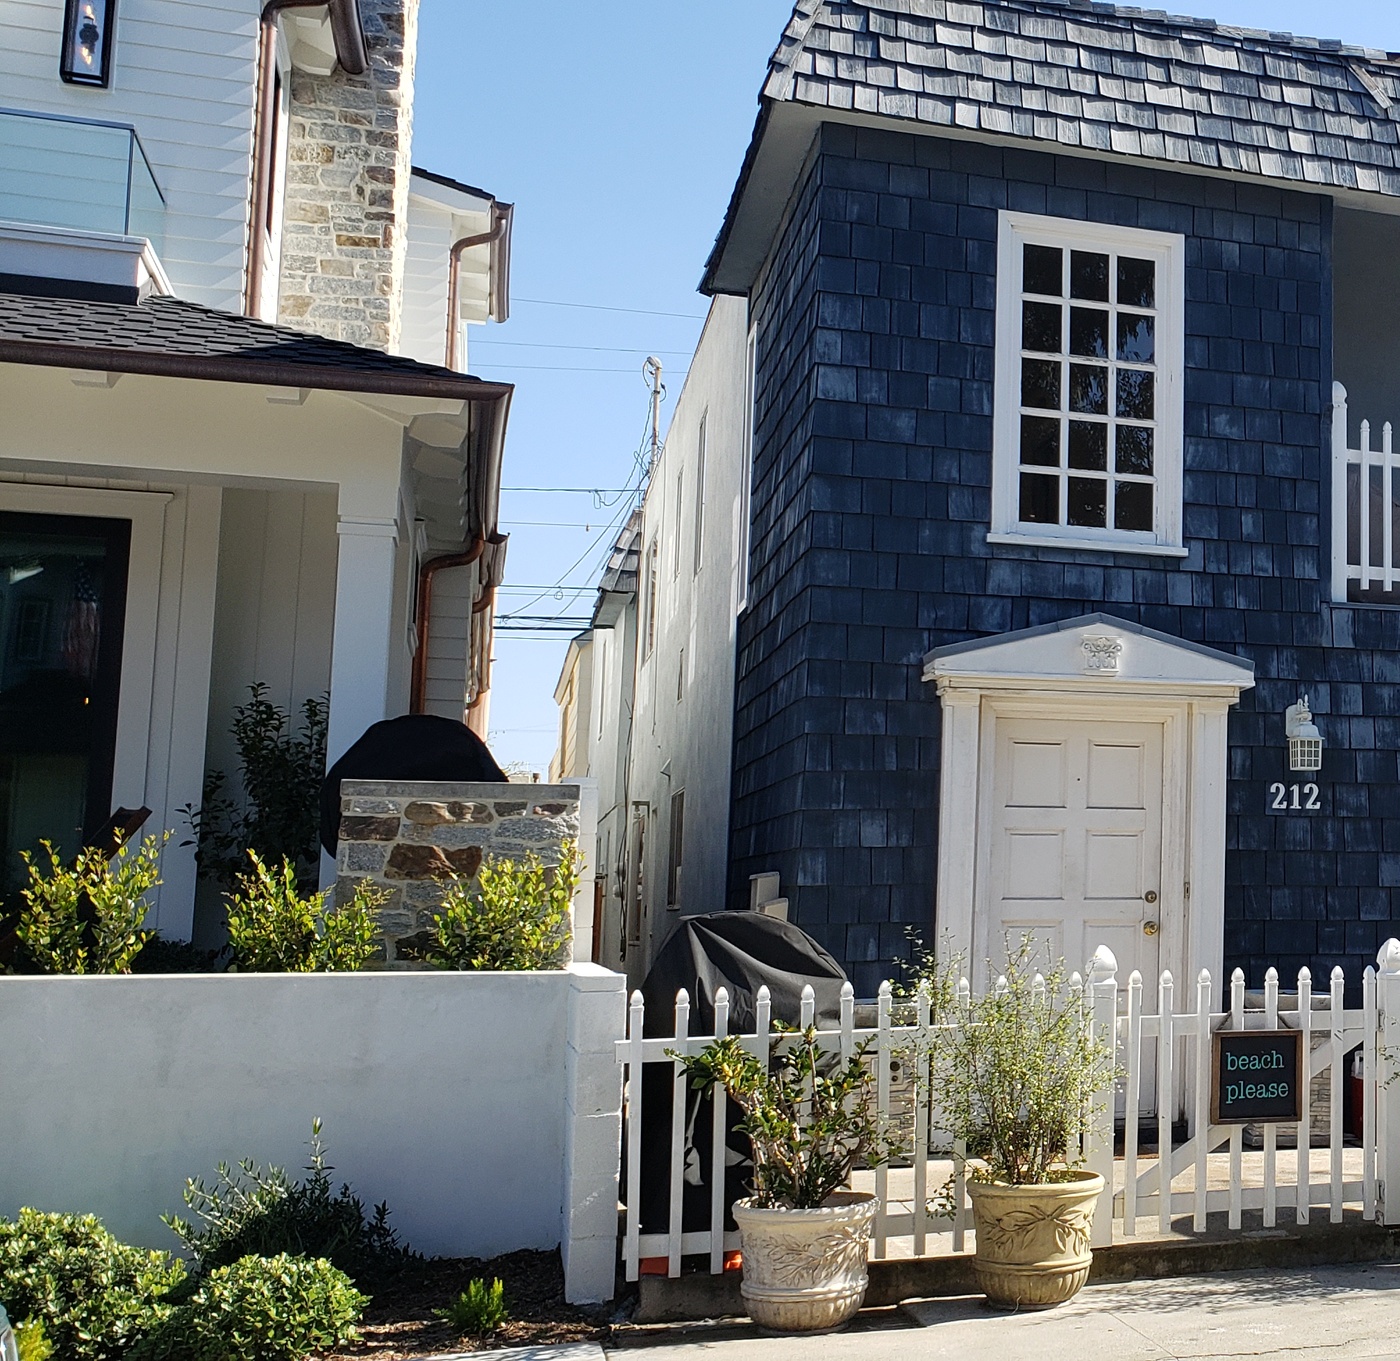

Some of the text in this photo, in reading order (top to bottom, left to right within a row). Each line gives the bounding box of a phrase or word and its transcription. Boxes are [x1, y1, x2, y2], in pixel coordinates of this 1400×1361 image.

[1269, 782, 1322, 810] 212
[1225, 1050, 1285, 1071] beach
[1225, 1080, 1289, 1104] please
